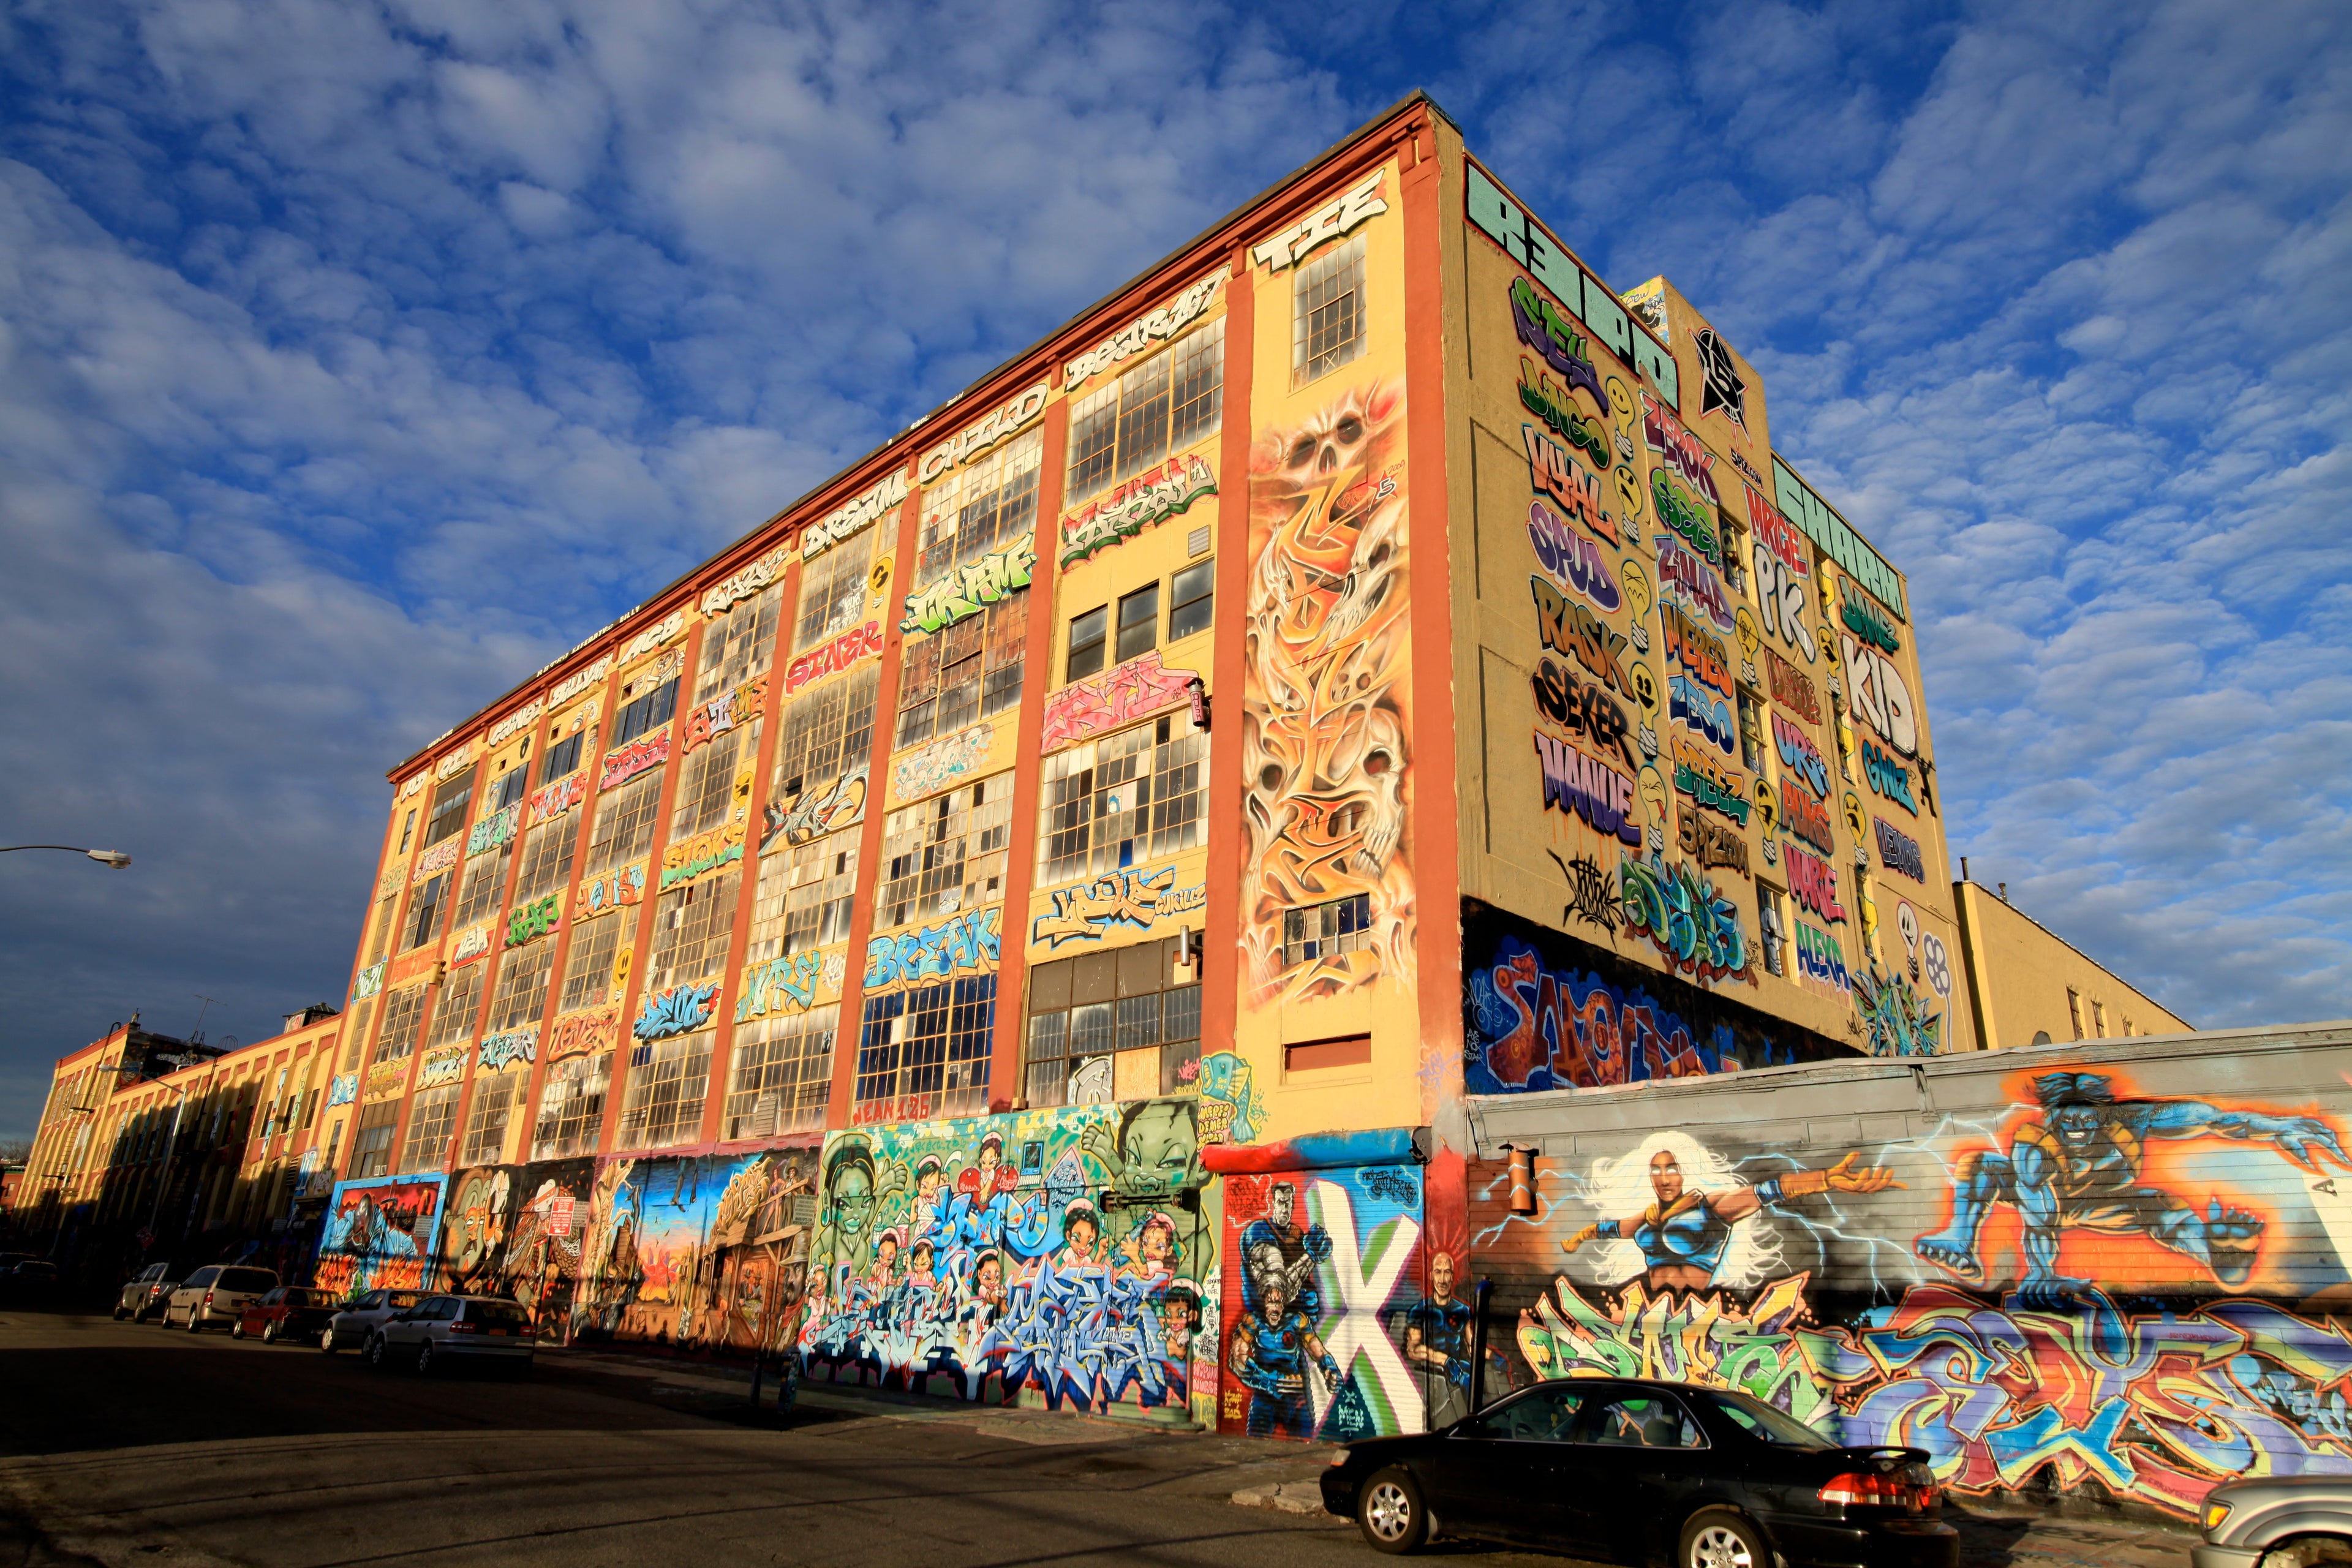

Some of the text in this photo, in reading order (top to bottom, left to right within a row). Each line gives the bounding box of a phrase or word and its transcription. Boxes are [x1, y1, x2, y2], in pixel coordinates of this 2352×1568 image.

[1251, 167, 1389, 276] TIE
[918, 381, 1049, 486] CHILD
[802, 466, 910, 562] DREAM
[1527, 500, 1623, 614] SPUD
[1529, 573, 1638, 703] RASK
[1658, 600, 1734, 700] MERES
[1841, 631, 1917, 763] KID
